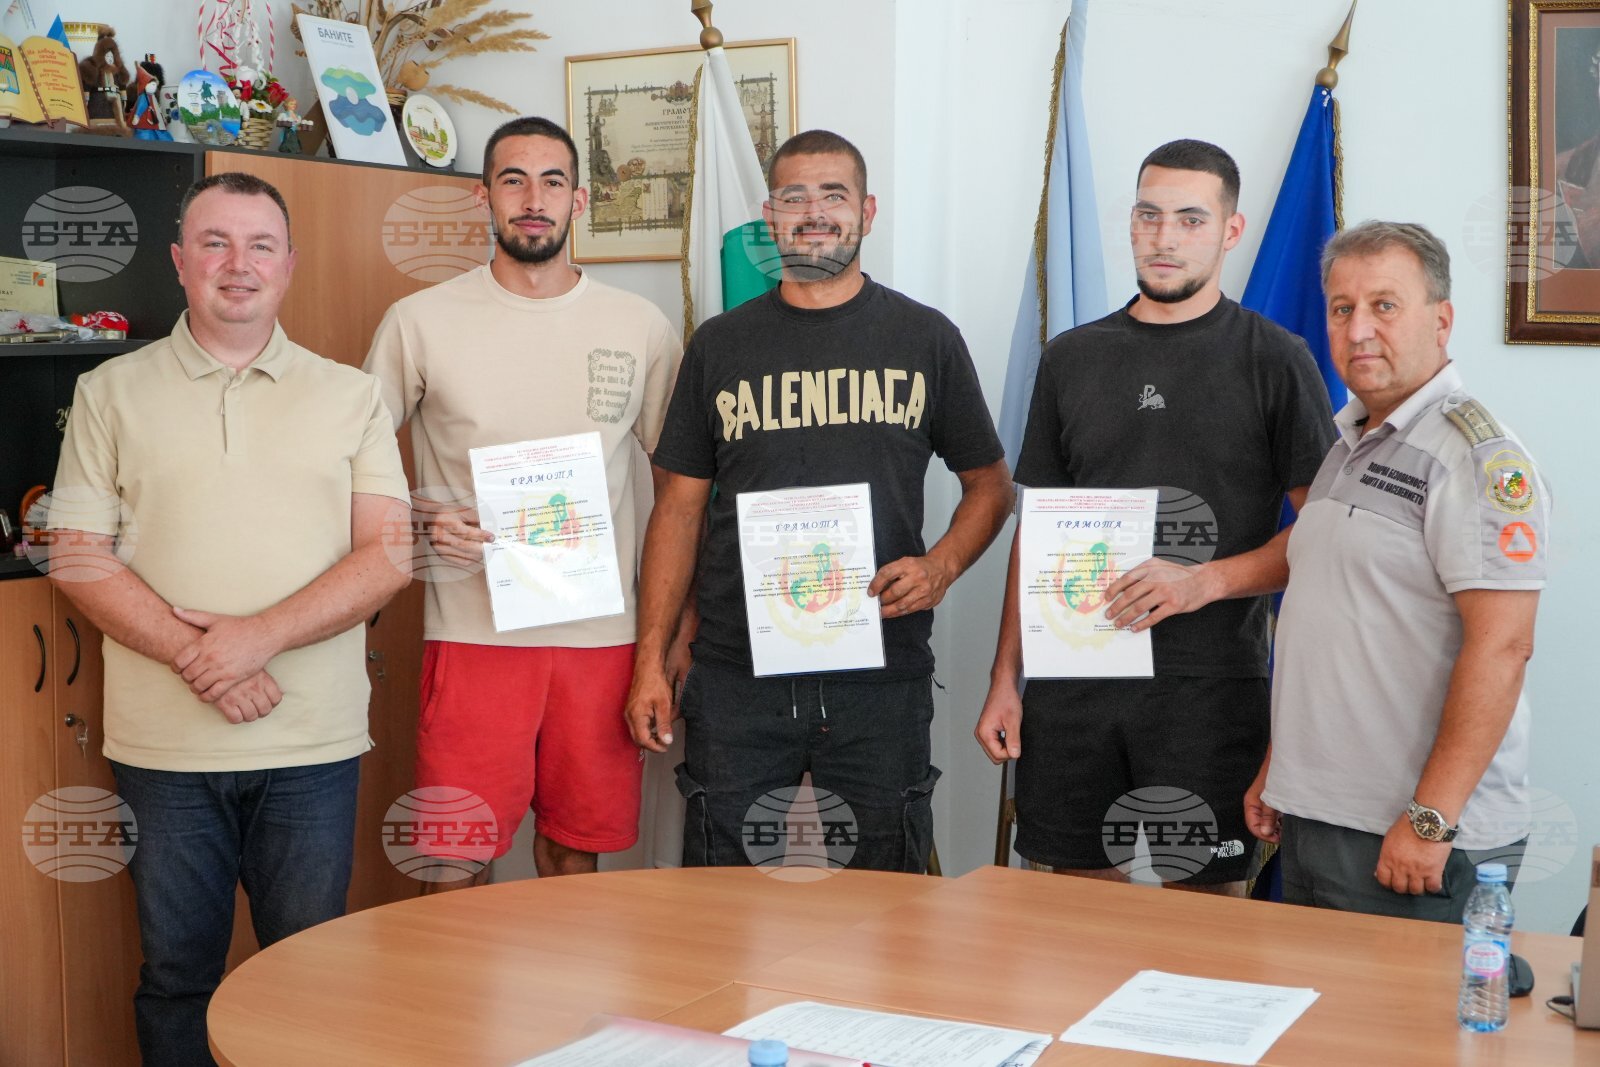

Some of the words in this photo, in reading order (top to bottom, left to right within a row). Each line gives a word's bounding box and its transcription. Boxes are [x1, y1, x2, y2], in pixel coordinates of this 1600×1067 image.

[318, 27, 354, 43] БАНИТЕ
[662, 107, 691, 116] ГРАМОТ
[716, 368, 926, 442] BALENCIAGA
[510, 469, 574, 486] ГРАМОТА
[775, 519, 840, 532] ГРАМОТА
[1056, 520, 1122, 529] ГРАМОТА
